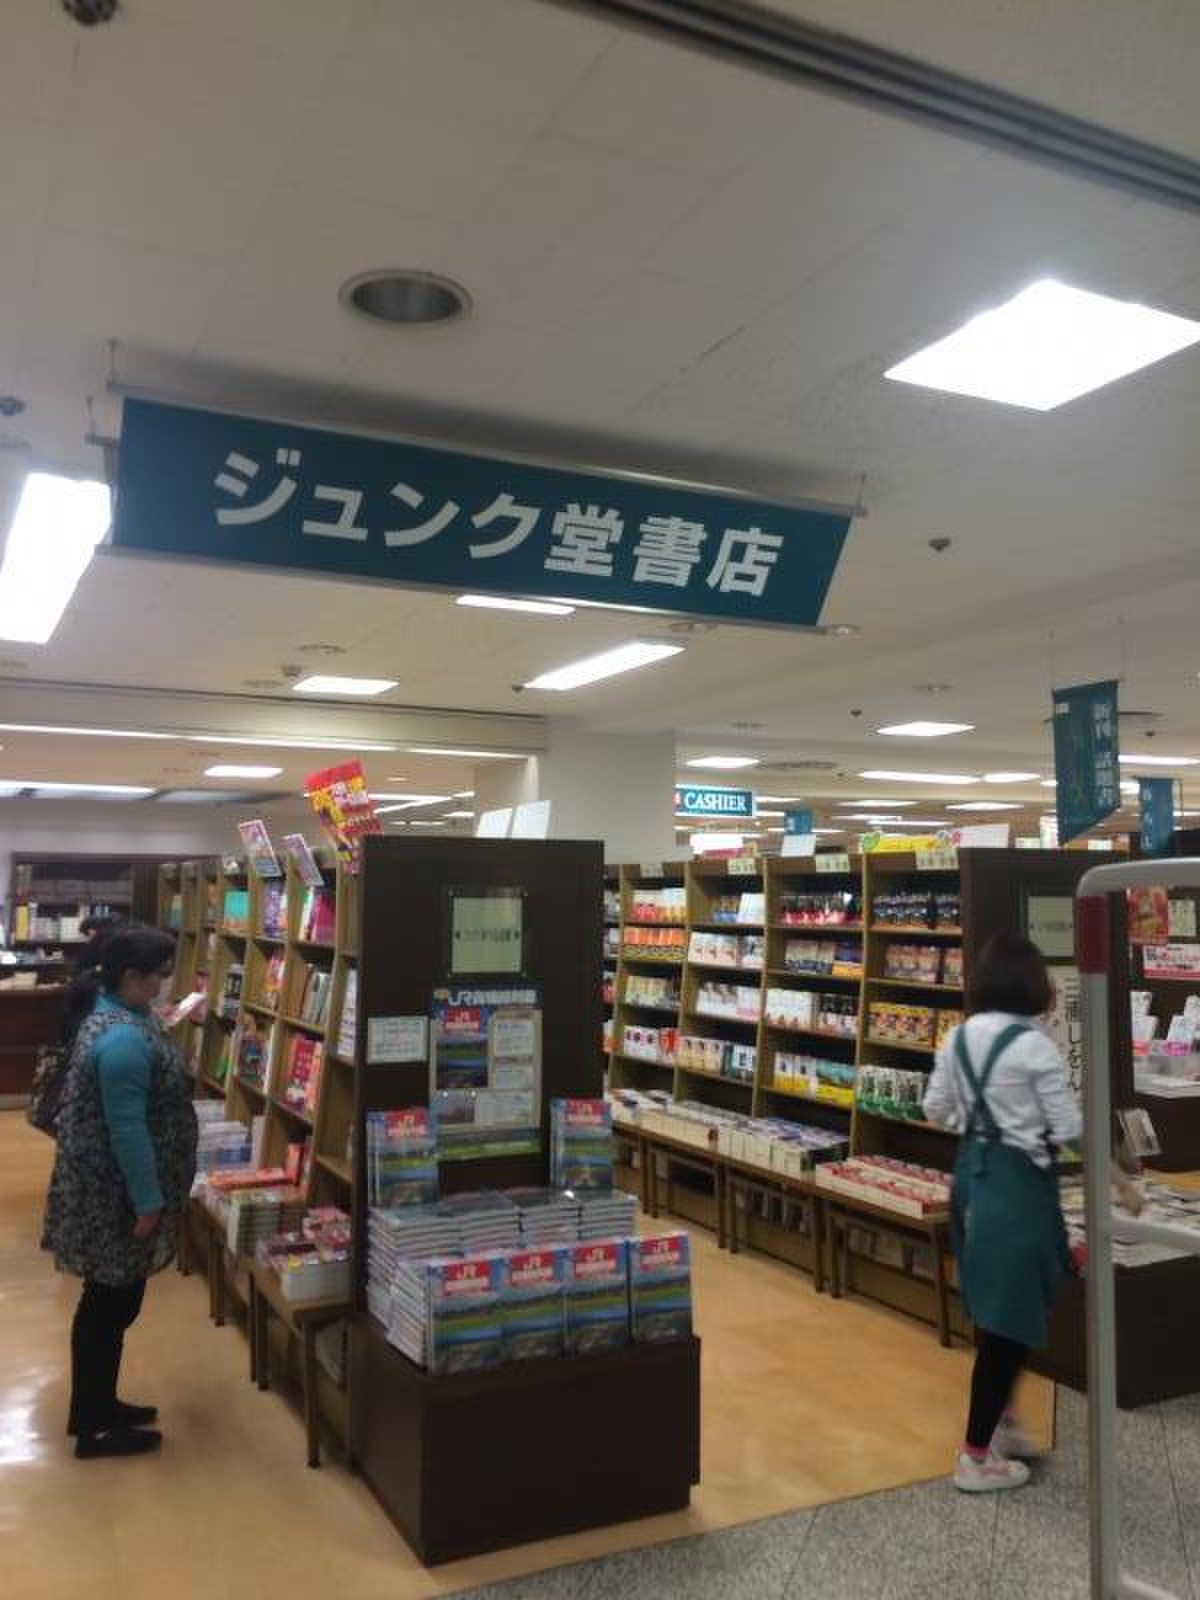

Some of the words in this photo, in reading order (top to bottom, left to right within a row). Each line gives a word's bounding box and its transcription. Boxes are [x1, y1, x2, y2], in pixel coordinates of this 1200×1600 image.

[213, 447, 785, 598] ジュンク堂書店
[684, 791, 747, 811] CASHIER
